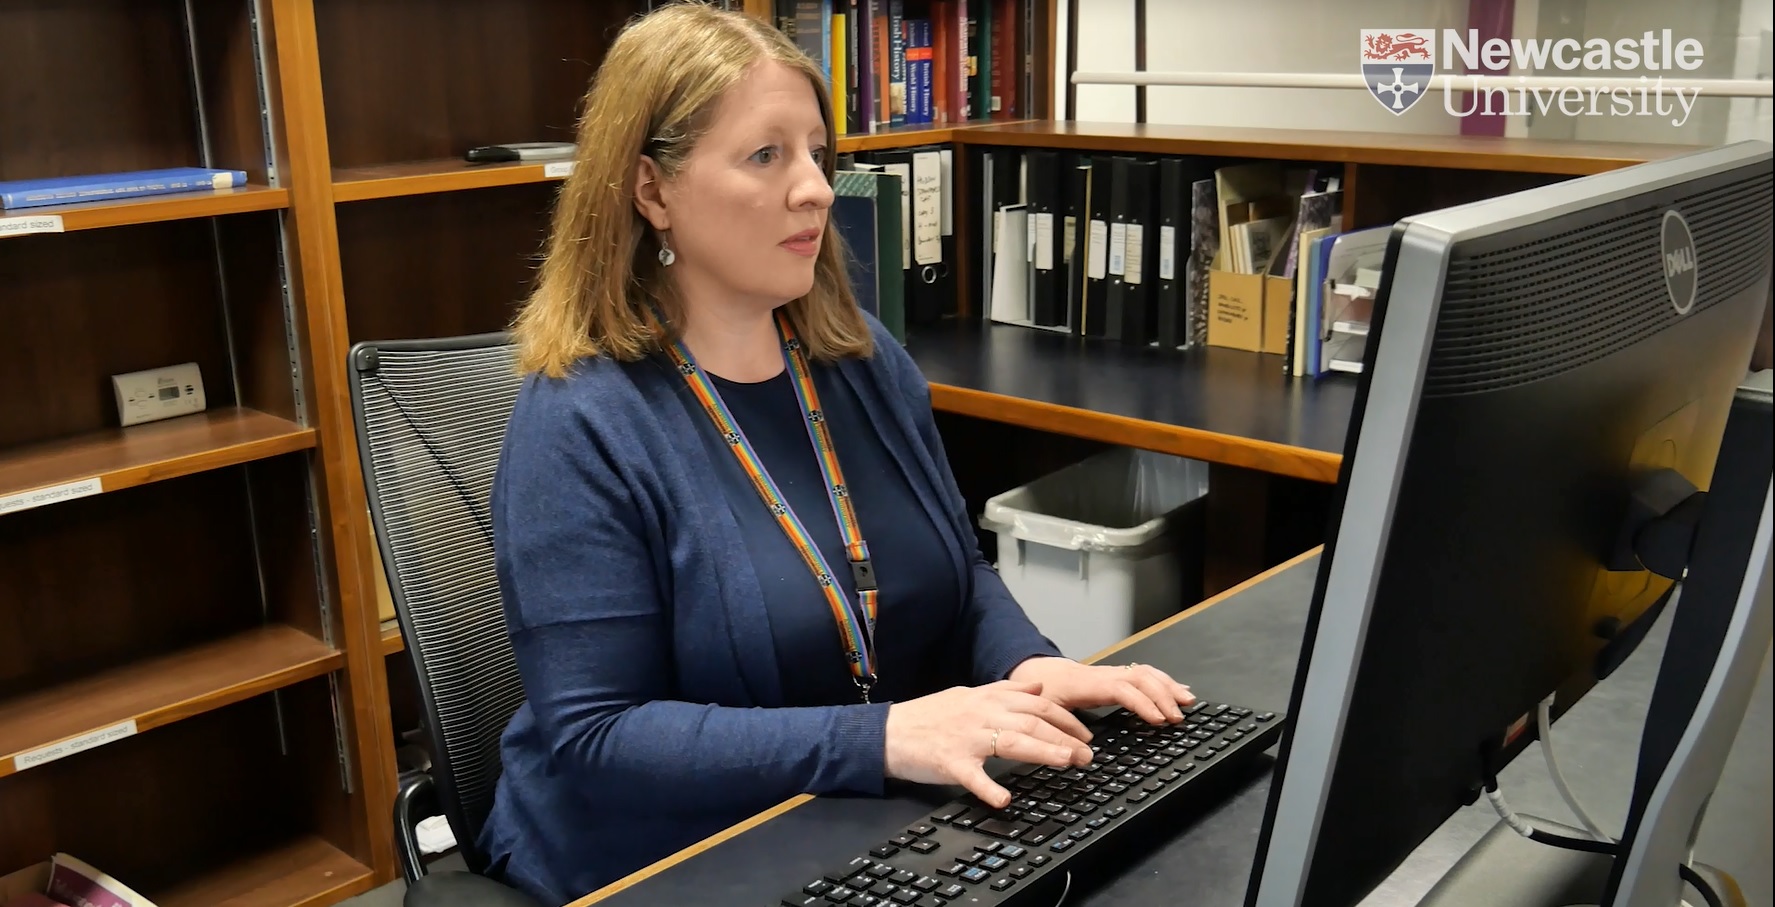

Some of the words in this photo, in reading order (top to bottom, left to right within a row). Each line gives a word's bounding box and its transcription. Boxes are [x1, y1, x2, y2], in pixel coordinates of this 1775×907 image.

[893, 15, 902, 38] Irish
[892, 40, 902, 80] History
[909, 63, 917, 85] World
[908, 86, 917, 113] History
[922, 88, 930, 116] History
[30, 219, 54, 229] sized
[1666, 246, 1694, 277] DELL
[0, 498, 24, 511] uests
[32, 489, 70, 503] standard
[71, 484, 93, 495] sized
[23, 747, 63, 764] Requests
[71, 732, 105, 750] standard
[107, 726, 128, 739] sized
